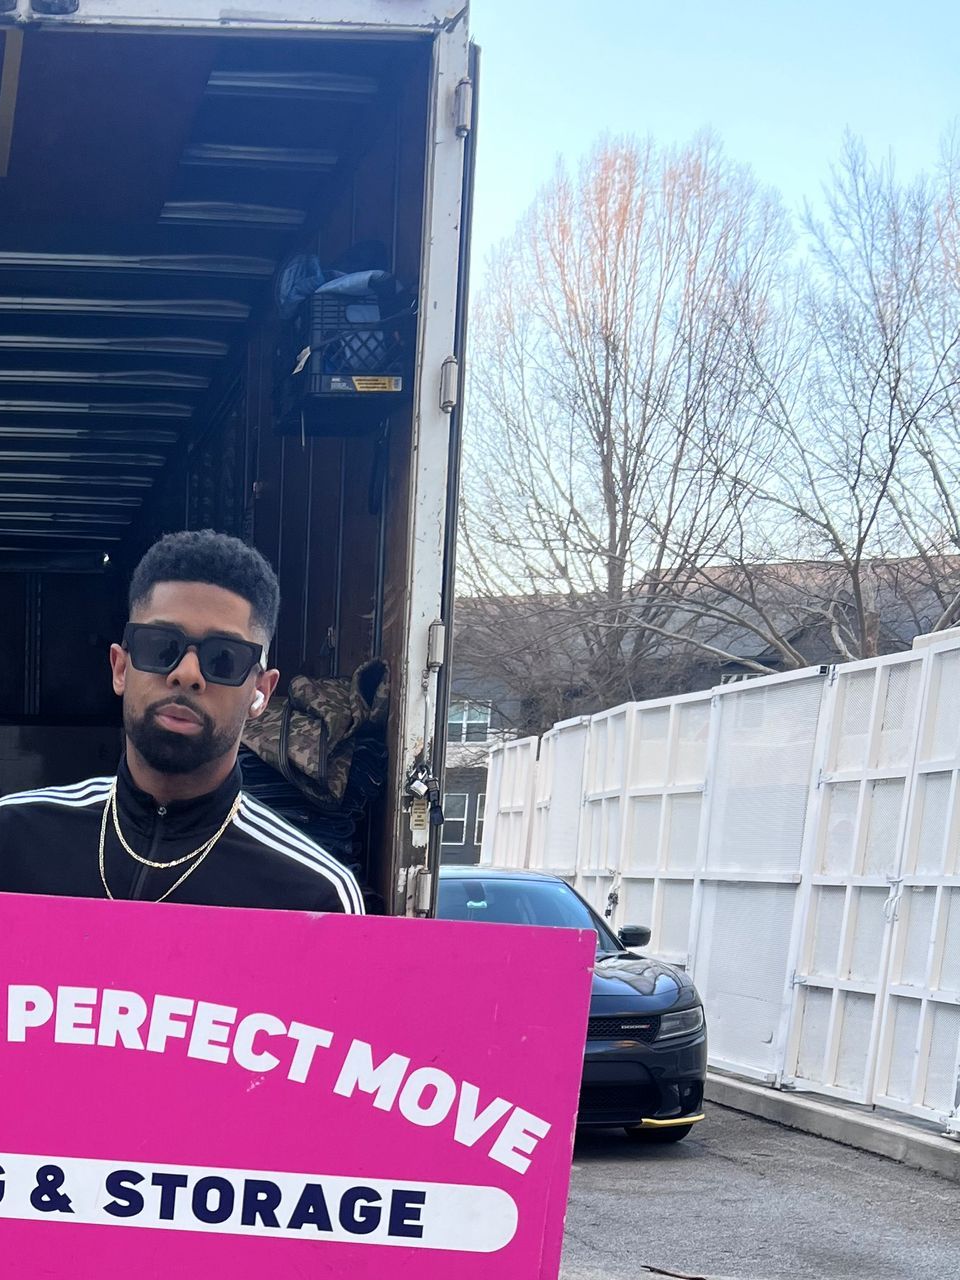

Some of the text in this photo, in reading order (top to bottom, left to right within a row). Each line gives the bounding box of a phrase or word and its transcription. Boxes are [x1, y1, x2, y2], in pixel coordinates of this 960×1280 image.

[7, 985, 333, 1083] PERFECT
[333, 1038, 552, 1175] MOVE
[29, 1164, 75, 1214] &
[103, 1169, 427, 1239] STORAGE
